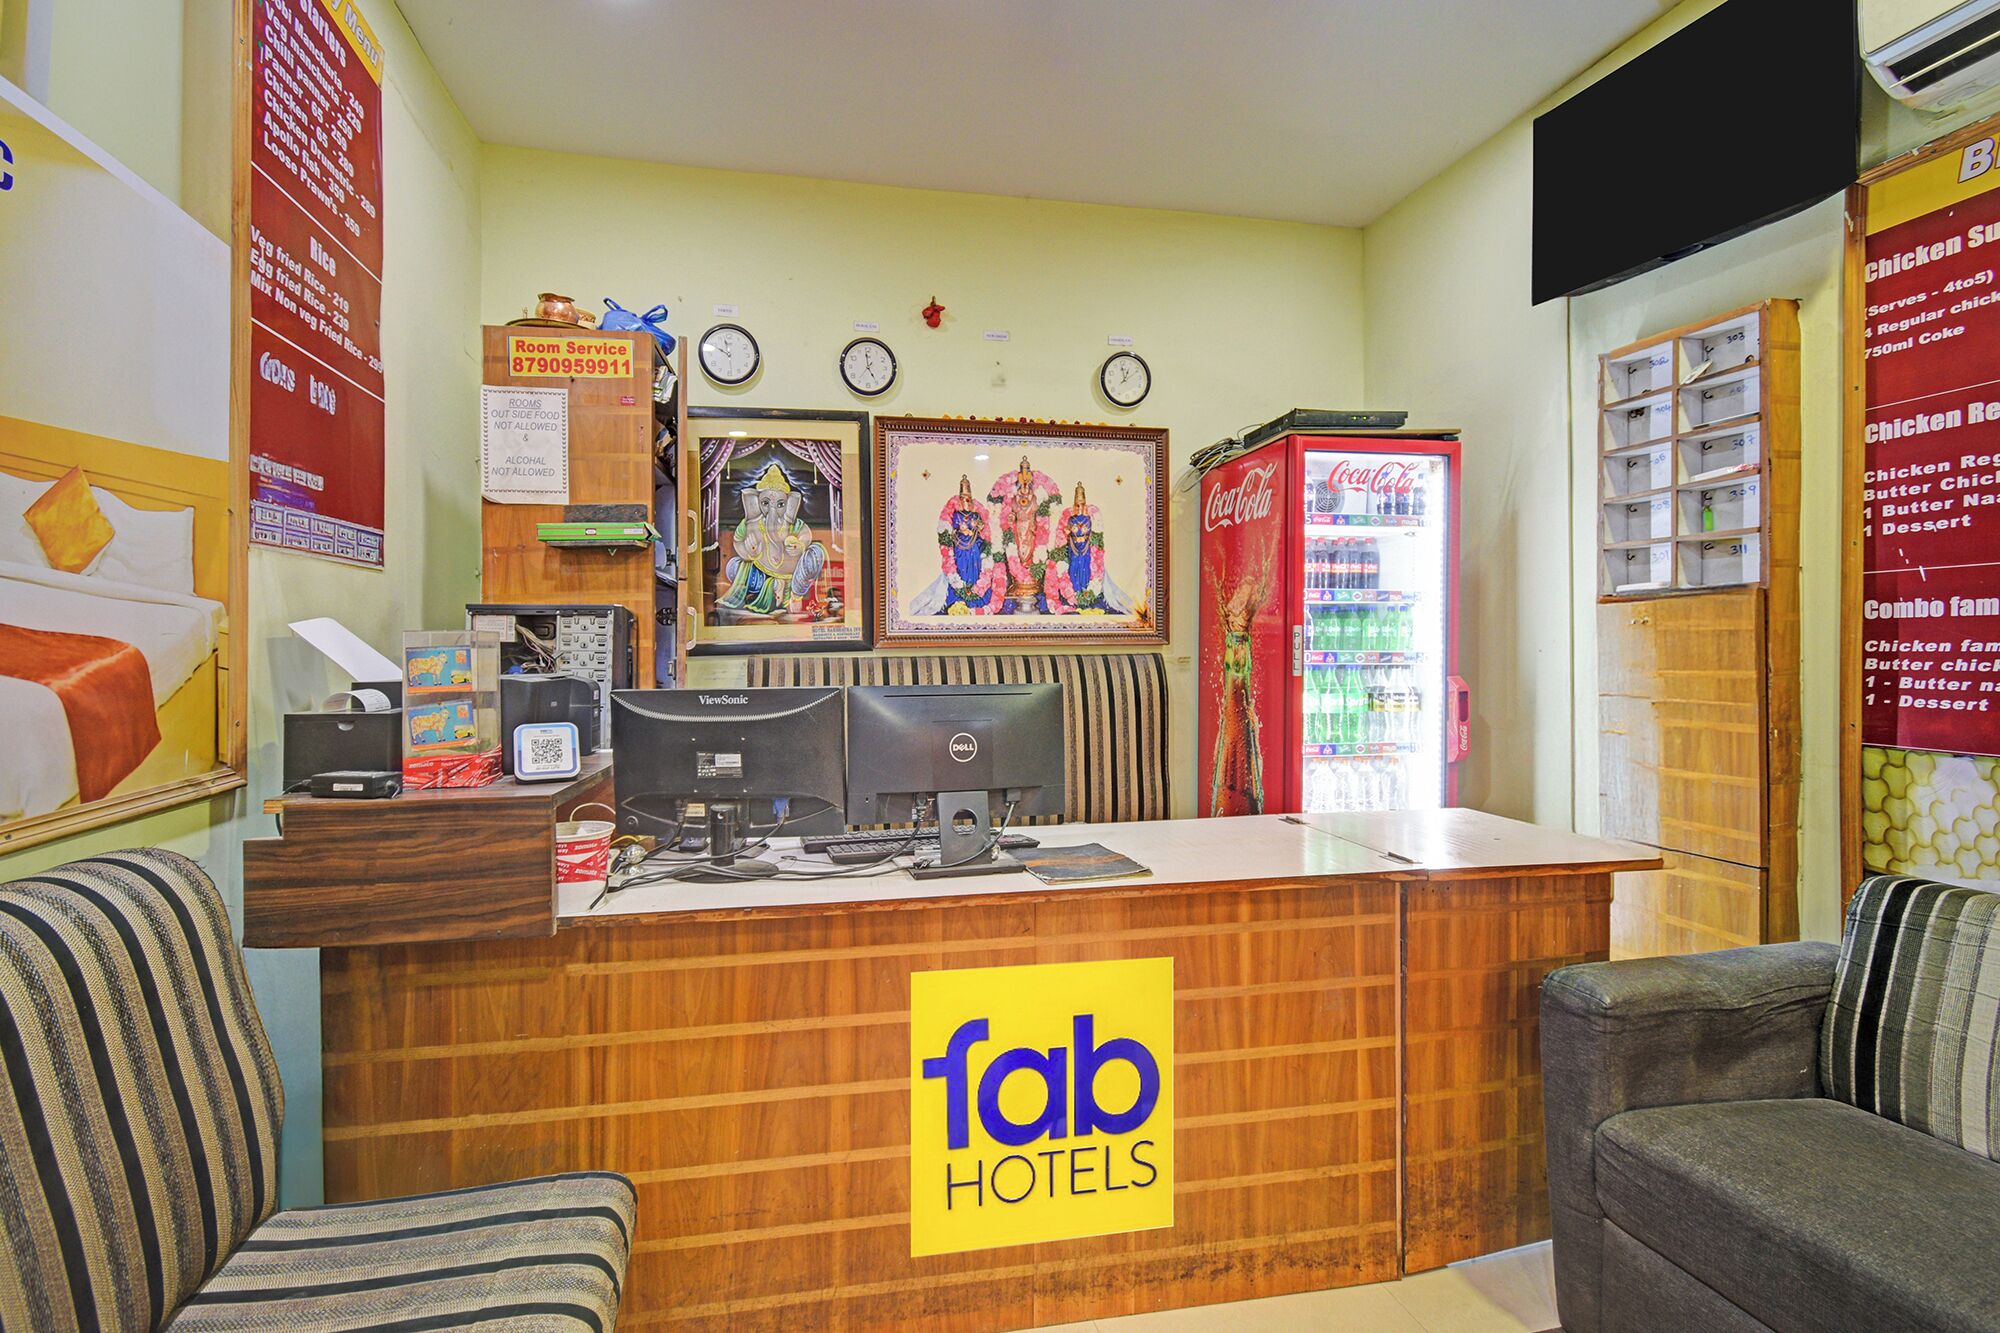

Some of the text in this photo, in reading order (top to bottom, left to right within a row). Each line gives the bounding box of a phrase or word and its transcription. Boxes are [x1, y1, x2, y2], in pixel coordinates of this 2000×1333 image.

[344, 4, 378, 66] Menu
[265, 1, 287, 42] Veg
[290, 36, 339, 106] manchuria
[275, 0, 292, 24] obi
[294, 17, 342, 92] Manchuria
[349, 92, 364, 119] 249
[264, 25, 294, 69] Chilli
[296, 65, 330, 112] Panner
[337, 112, 353, 140] 259
[264, 45, 303, 99] Panner
[311, 101, 323, 123] 65
[330, 123, 347, 151] 259
[264, 68, 308, 126] Chicken
[316, 126, 328, 148] 65
[264, 89, 308, 146] Chicken
[310, 138, 354, 197] Drumstric
[264, 111, 299, 157] Apollo
[302, 149, 320, 179] fish
[328, 177, 345, 203] 359
[264, 131, 298, 175] Loose
[300, 167, 338, 215] Prawn's
[345, 213, 360, 237] 359
[251, 225, 273, 257] Veg
[276, 247, 301, 276] fried
[304, 266, 326, 295] Rice
[310, 236, 336, 277] Rice
[1864, 235, 1962, 284] Chicken
[251, 248, 273, 278] Egg
[276, 267, 301, 296] fried
[304, 285, 325, 314] Rice
[333, 311, 349, 332] 239
[1943, 269, 1994, 294] 4to5)
[251, 270, 272, 298] Mix
[275, 287, 297, 314] Non
[300, 307, 317, 330] veg
[320, 320, 342, 346] Fried
[344, 335, 362, 360] Rice
[1877, 307, 1946, 335] Regular
[515, 340, 627, 355] Room Service
[1726, 332, 1745, 344] 303
[1864, 325, 1965, 359] 750ml Coke
[513, 357, 631, 374] 8790959911
[509, 399, 542, 407] ROOMS
[491, 410, 560, 420] OUT SIDE FOOD
[494, 421, 557, 431] NOT ALLOWED
[1864, 409, 1962, 443] Chicken
[523, 433, 528, 441] &
[491, 467, 555, 476] NOT ALLOWED
[505, 456, 546, 465] ALCOHAL
[1864, 461, 1951, 483] Chicken
[1864, 482, 1932, 501] Butter
[1882, 499, 1954, 517] Butter
[1882, 514, 1972, 535] Dessert
[1729, 544, 1747, 555] 311
[1864, 598, 1945, 619] Combo
[1293, 631, 1301, 670] PULL
[1864, 640, 1951, 652] Chicken
[1864, 658, 1933, 671] Butter
[1865, 676, 1876, 688] 1
[1899, 677, 1972, 691] Butter
[698, 694, 749, 704] ViewSonic
[1865, 694, 1876, 705] 1
[1899, 695, 1989, 711] Dessert
[952, 743, 974, 751] DELL
[922, 1013, 1160, 1150] fab
[947, 1140, 1157, 1210] HOTELS
